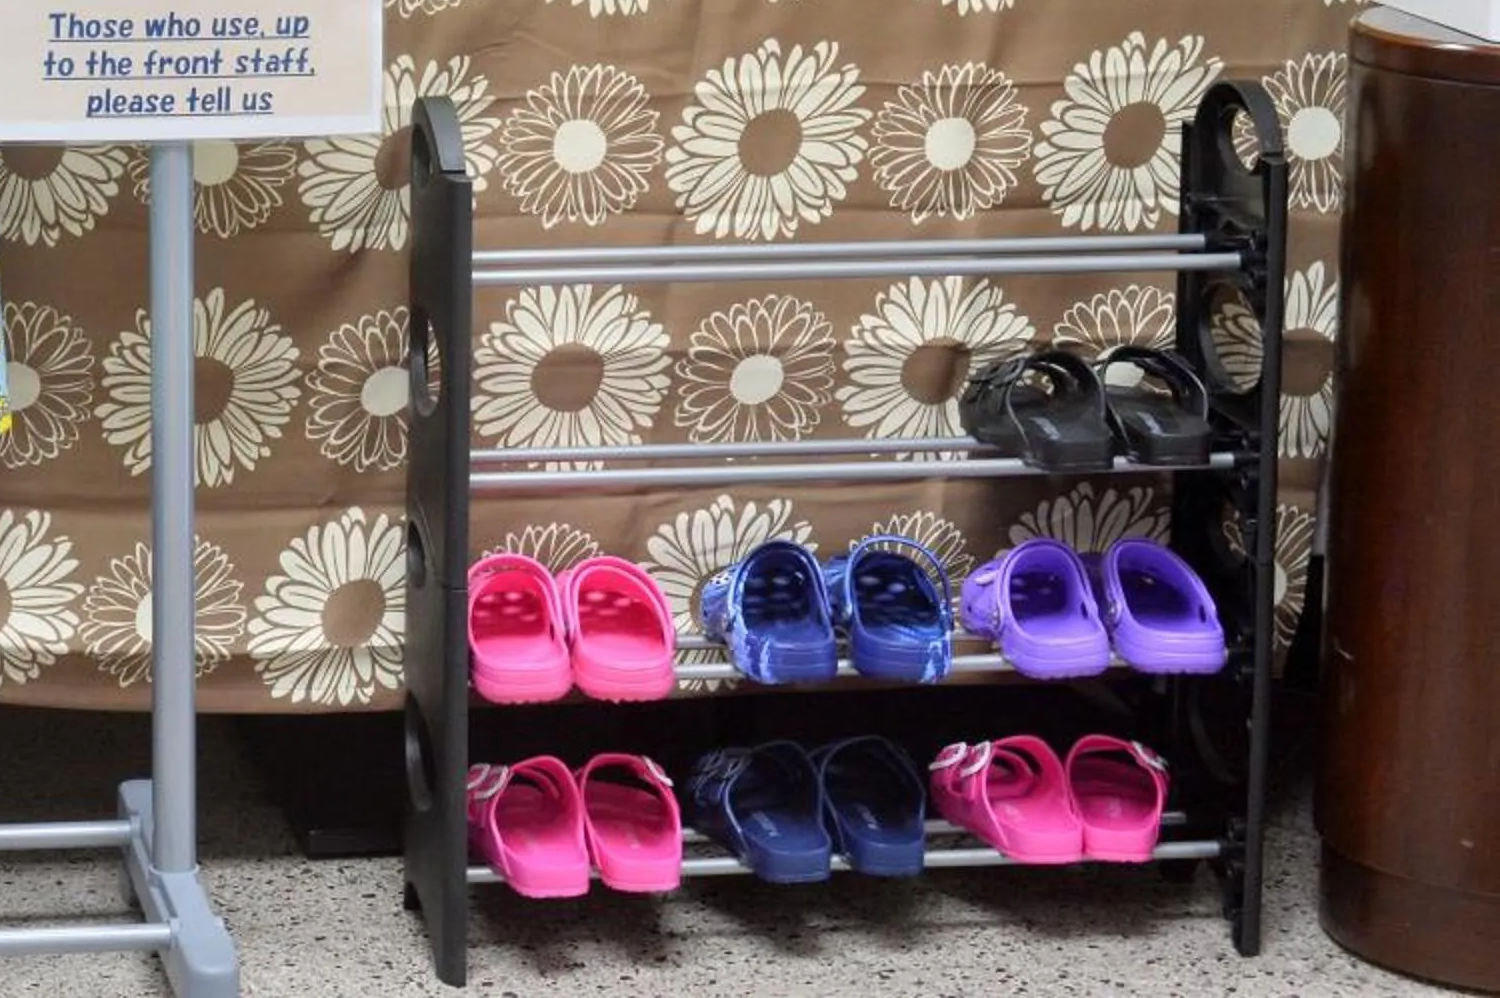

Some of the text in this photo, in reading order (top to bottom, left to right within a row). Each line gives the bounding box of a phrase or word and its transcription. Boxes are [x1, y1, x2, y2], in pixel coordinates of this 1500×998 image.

[49, 12, 135, 40] Those
[145, 11, 201, 37] who
[276, 15, 310, 39] up
[43, 50, 75, 77] to
[85, 50, 133, 76] the
[143, 48, 224, 76] front
[86, 85, 273, 118] please tell us
